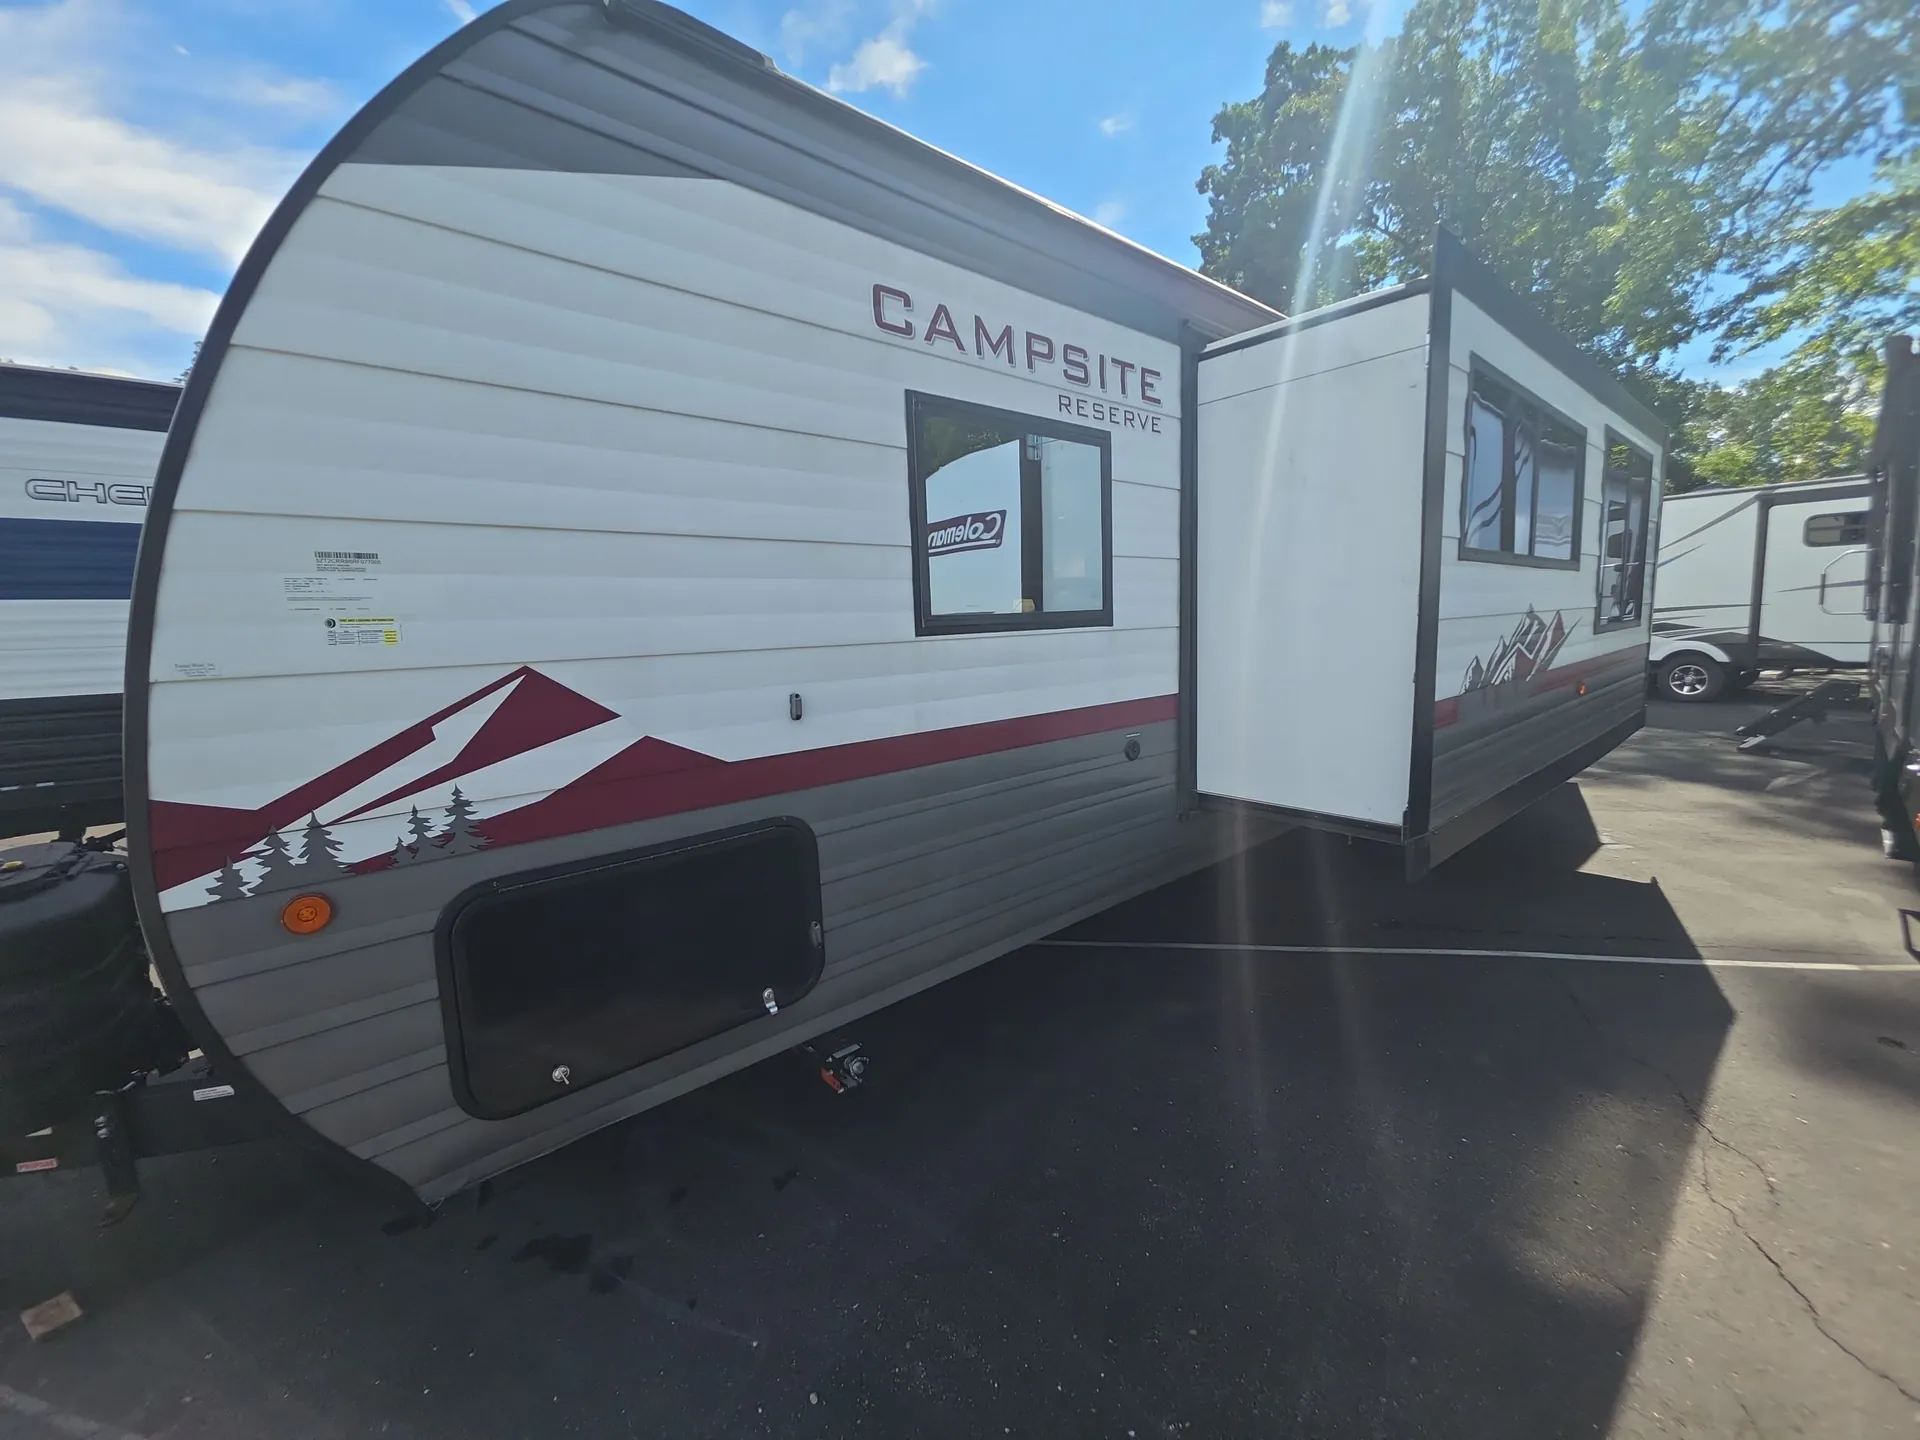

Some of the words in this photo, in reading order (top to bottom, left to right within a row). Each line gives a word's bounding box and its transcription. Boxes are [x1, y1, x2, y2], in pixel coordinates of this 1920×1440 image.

[872, 284, 1162, 406] CAMPSITE
[1058, 394, 1161, 433] RESERVE
[25, 478, 153, 506] CHE
